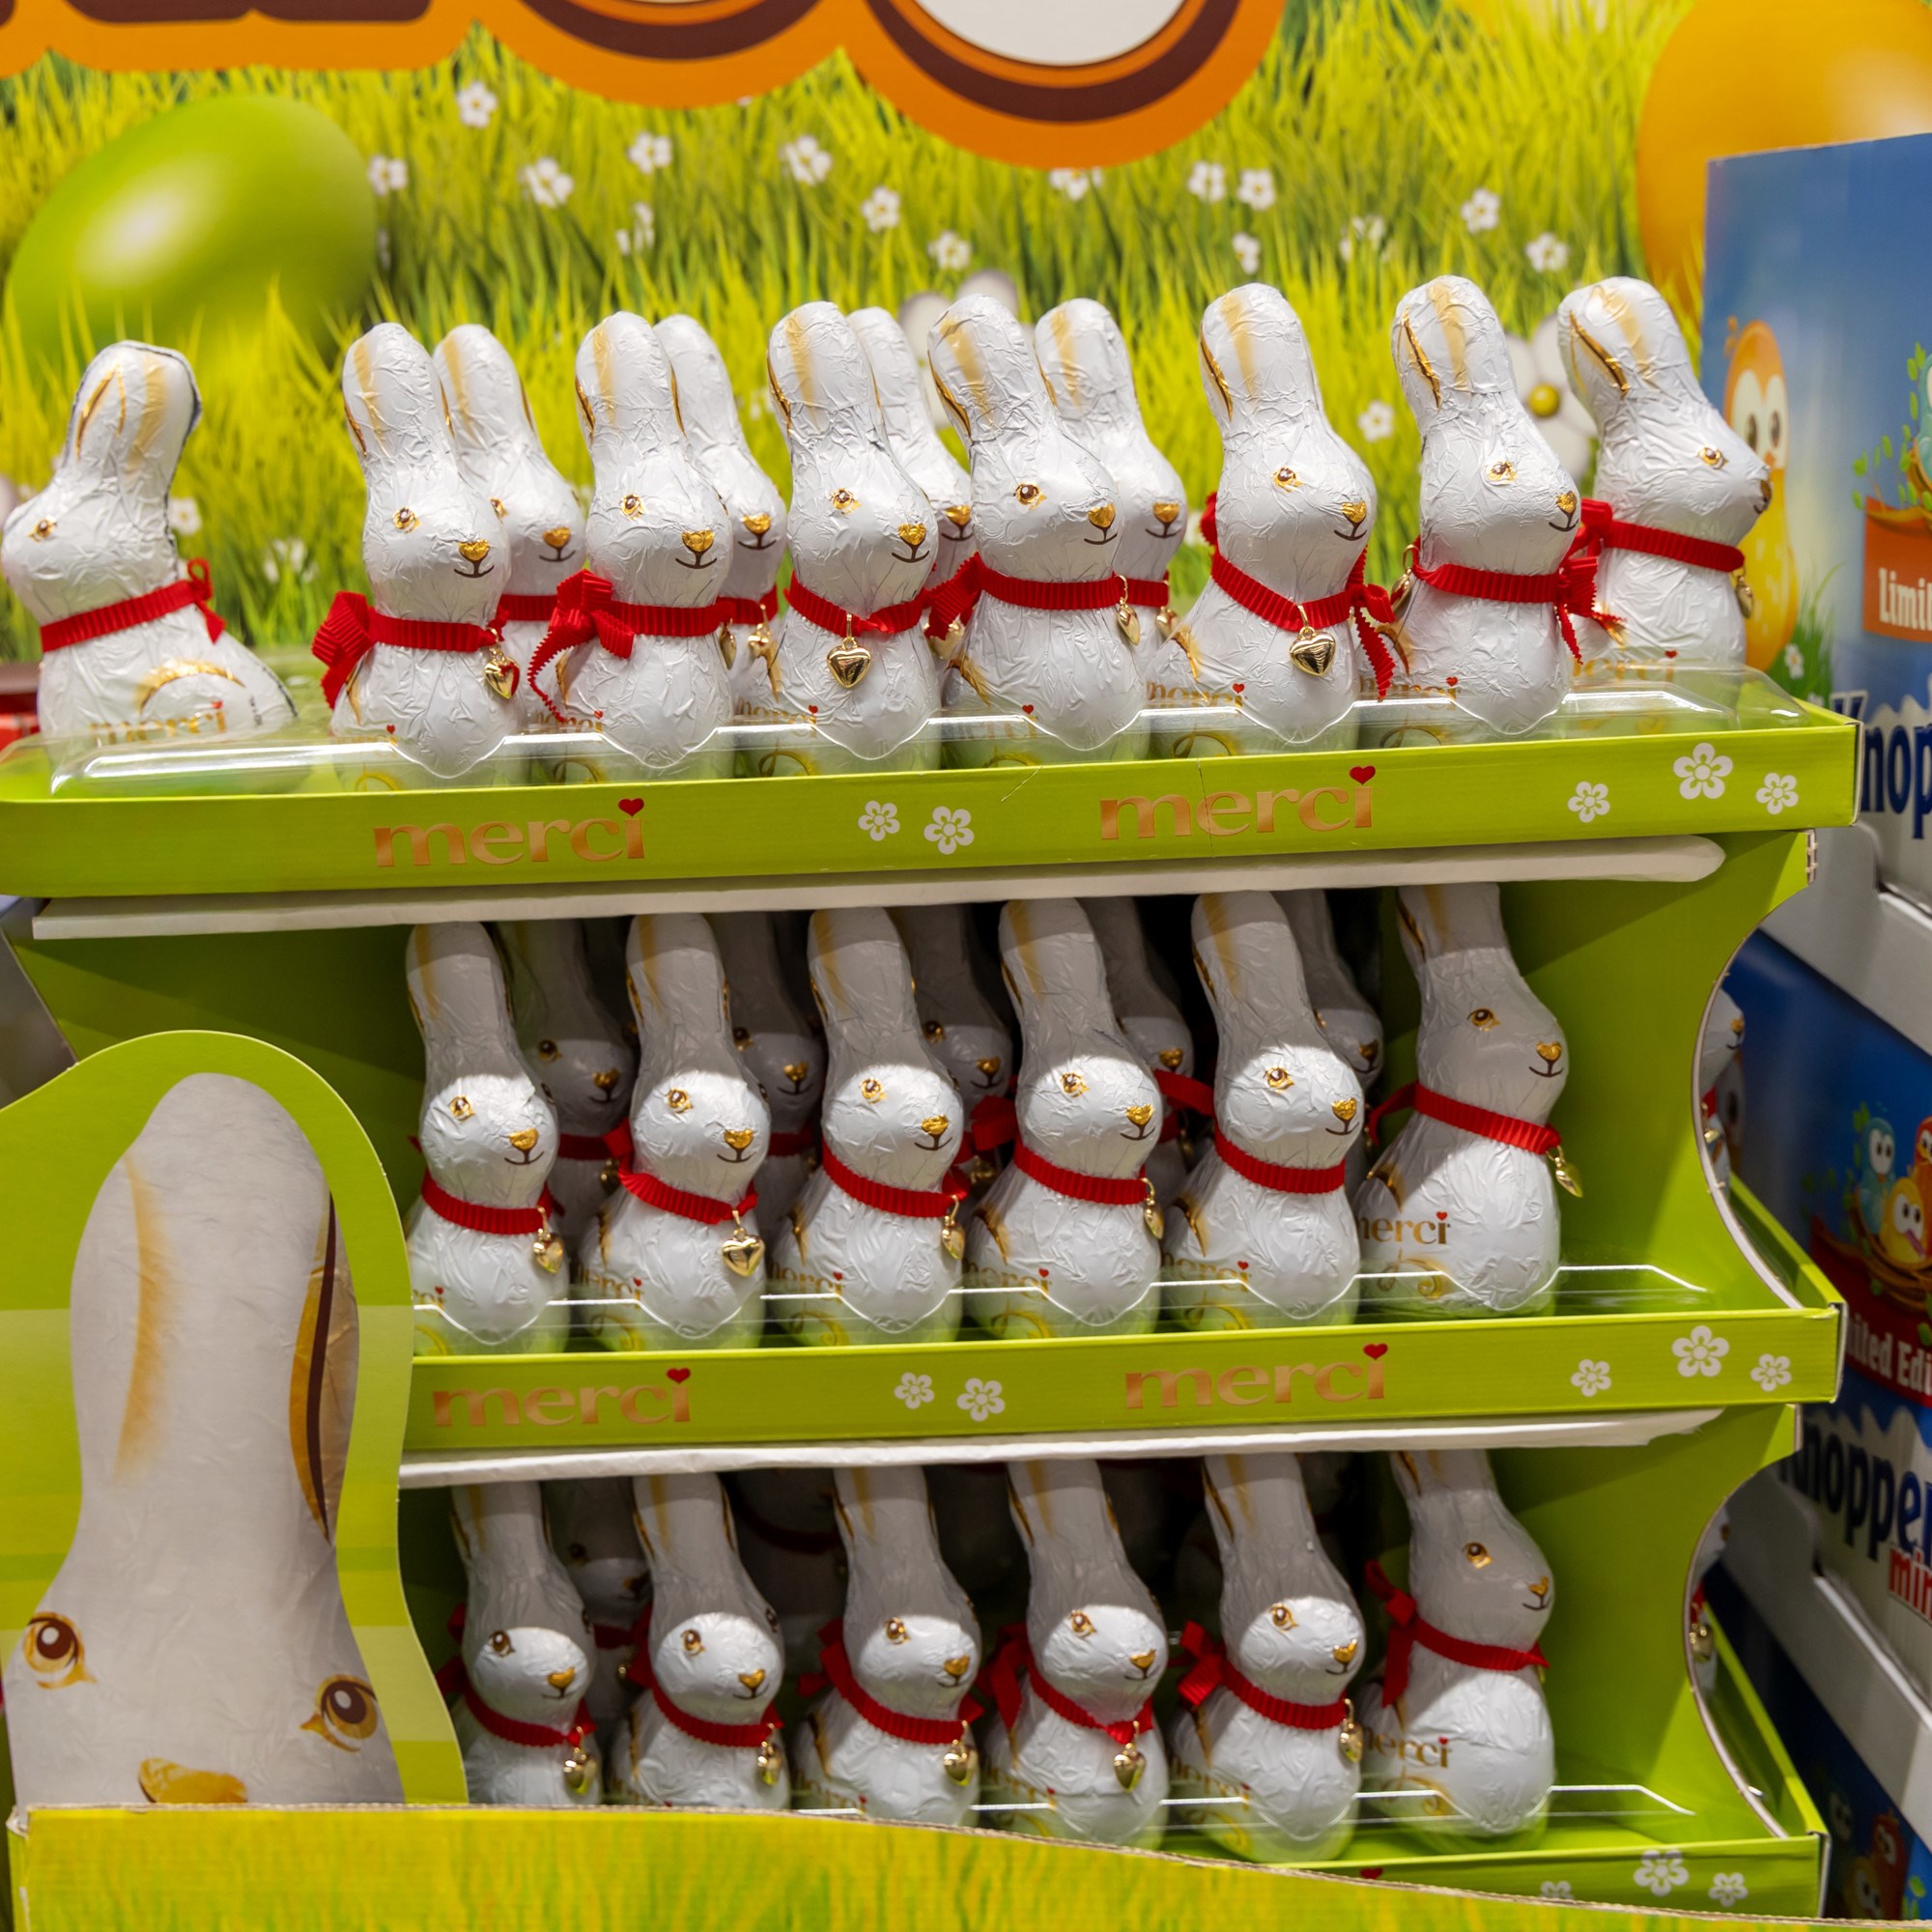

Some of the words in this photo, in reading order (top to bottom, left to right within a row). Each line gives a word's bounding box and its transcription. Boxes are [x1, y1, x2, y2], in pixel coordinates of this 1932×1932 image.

[1832, 694, 1932, 838] nop
[374, 798, 645, 867] merci
[1100, 766, 1376, 839] merci
[433, 1368, 691, 1427] merci
[1124, 1342, 1389, 1409] merci
